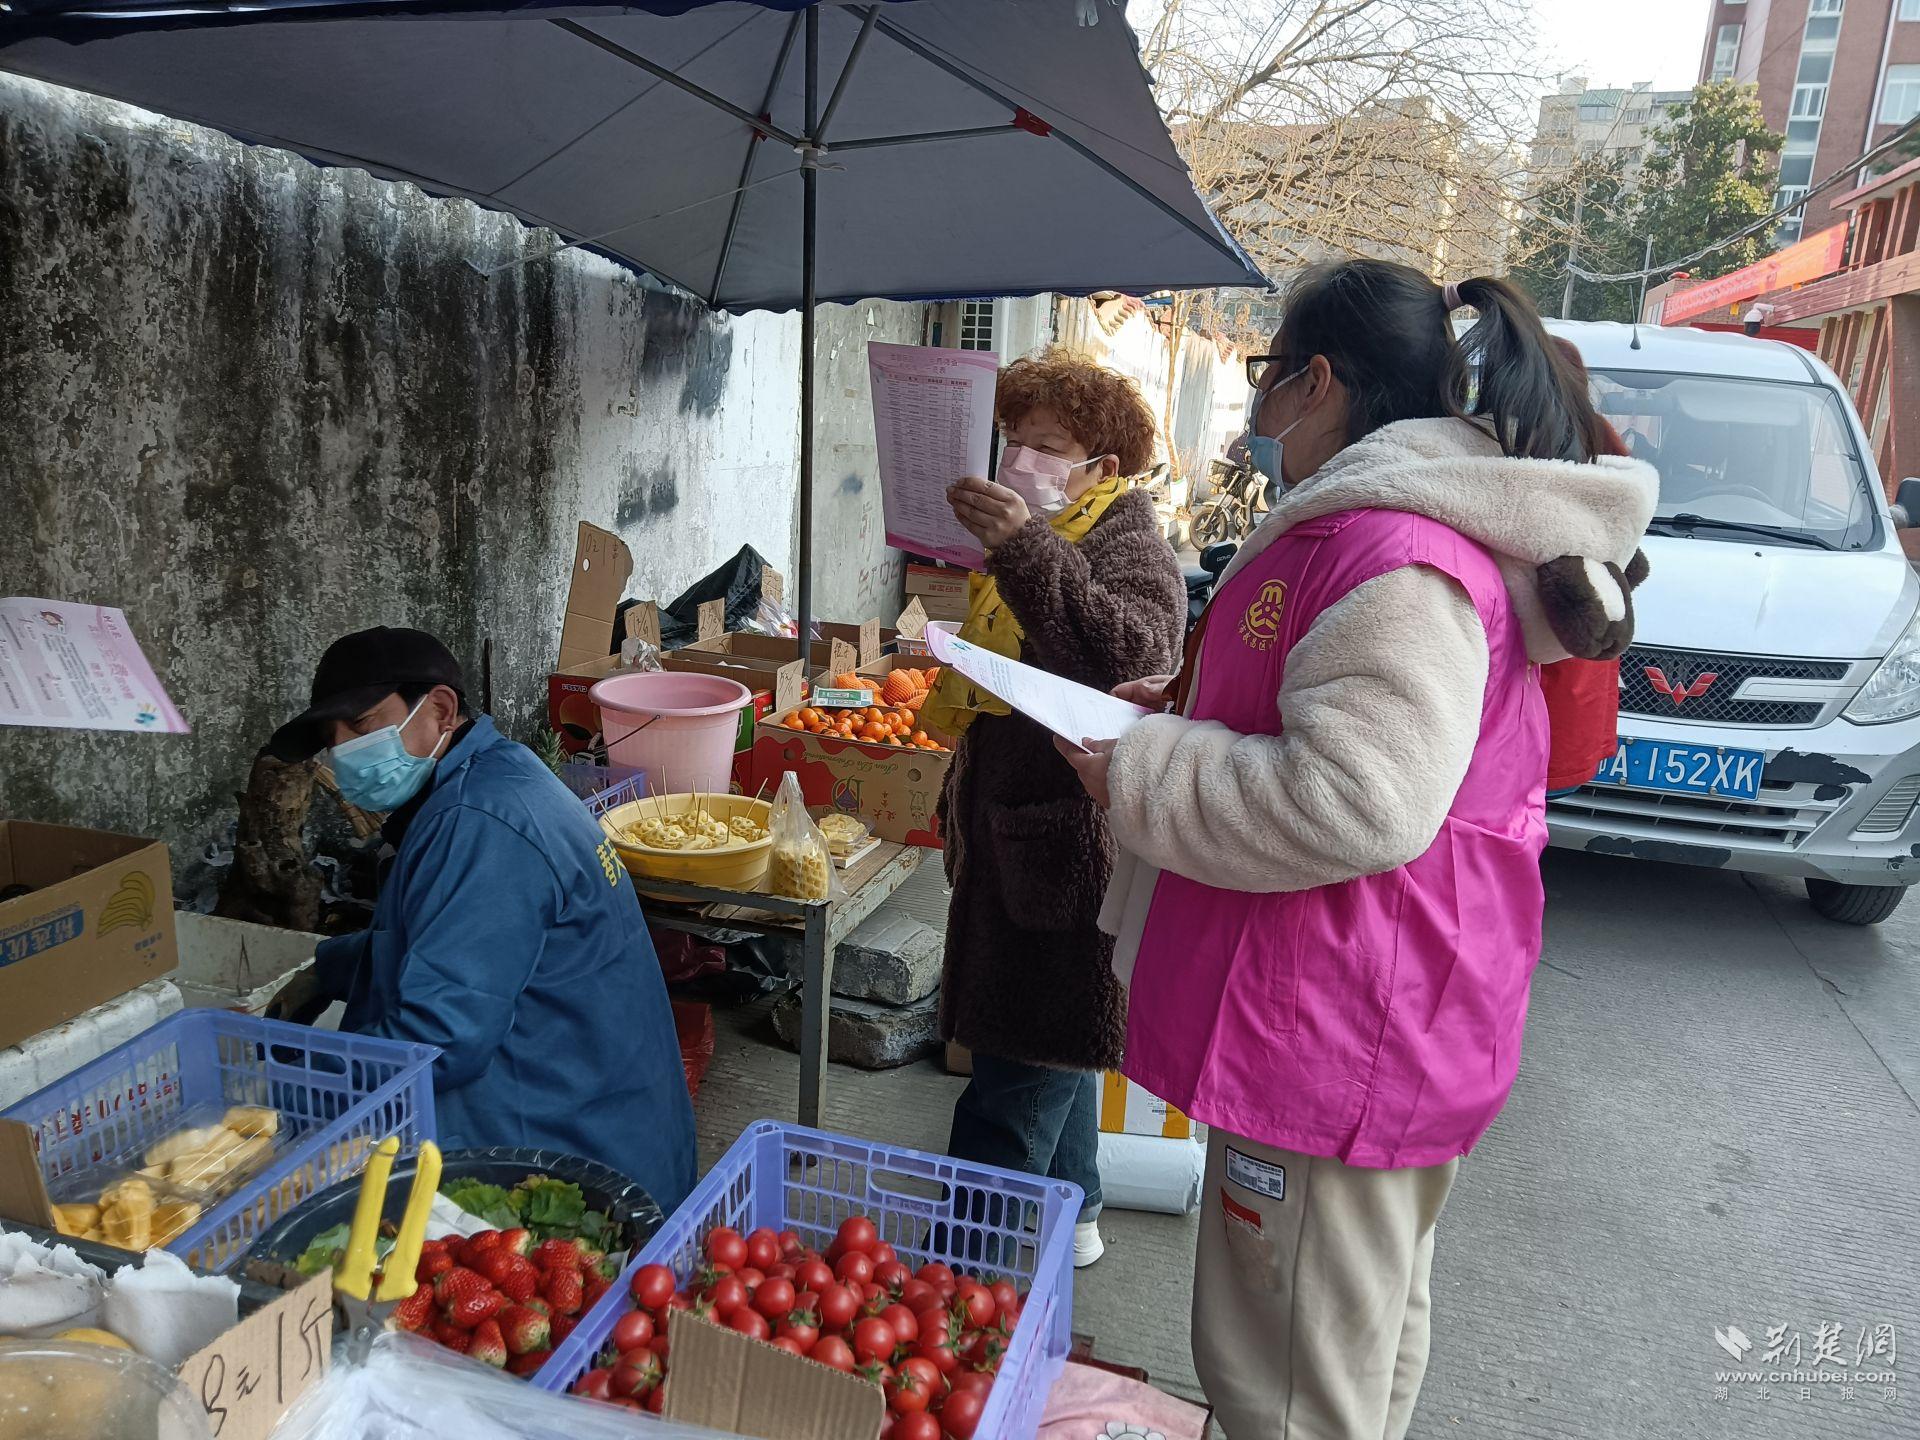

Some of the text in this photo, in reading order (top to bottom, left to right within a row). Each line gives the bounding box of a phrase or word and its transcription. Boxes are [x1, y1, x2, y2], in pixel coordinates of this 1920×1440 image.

[1599, 745, 1758, 792] A·152XK
[0, 916, 74, 961] 精选优
